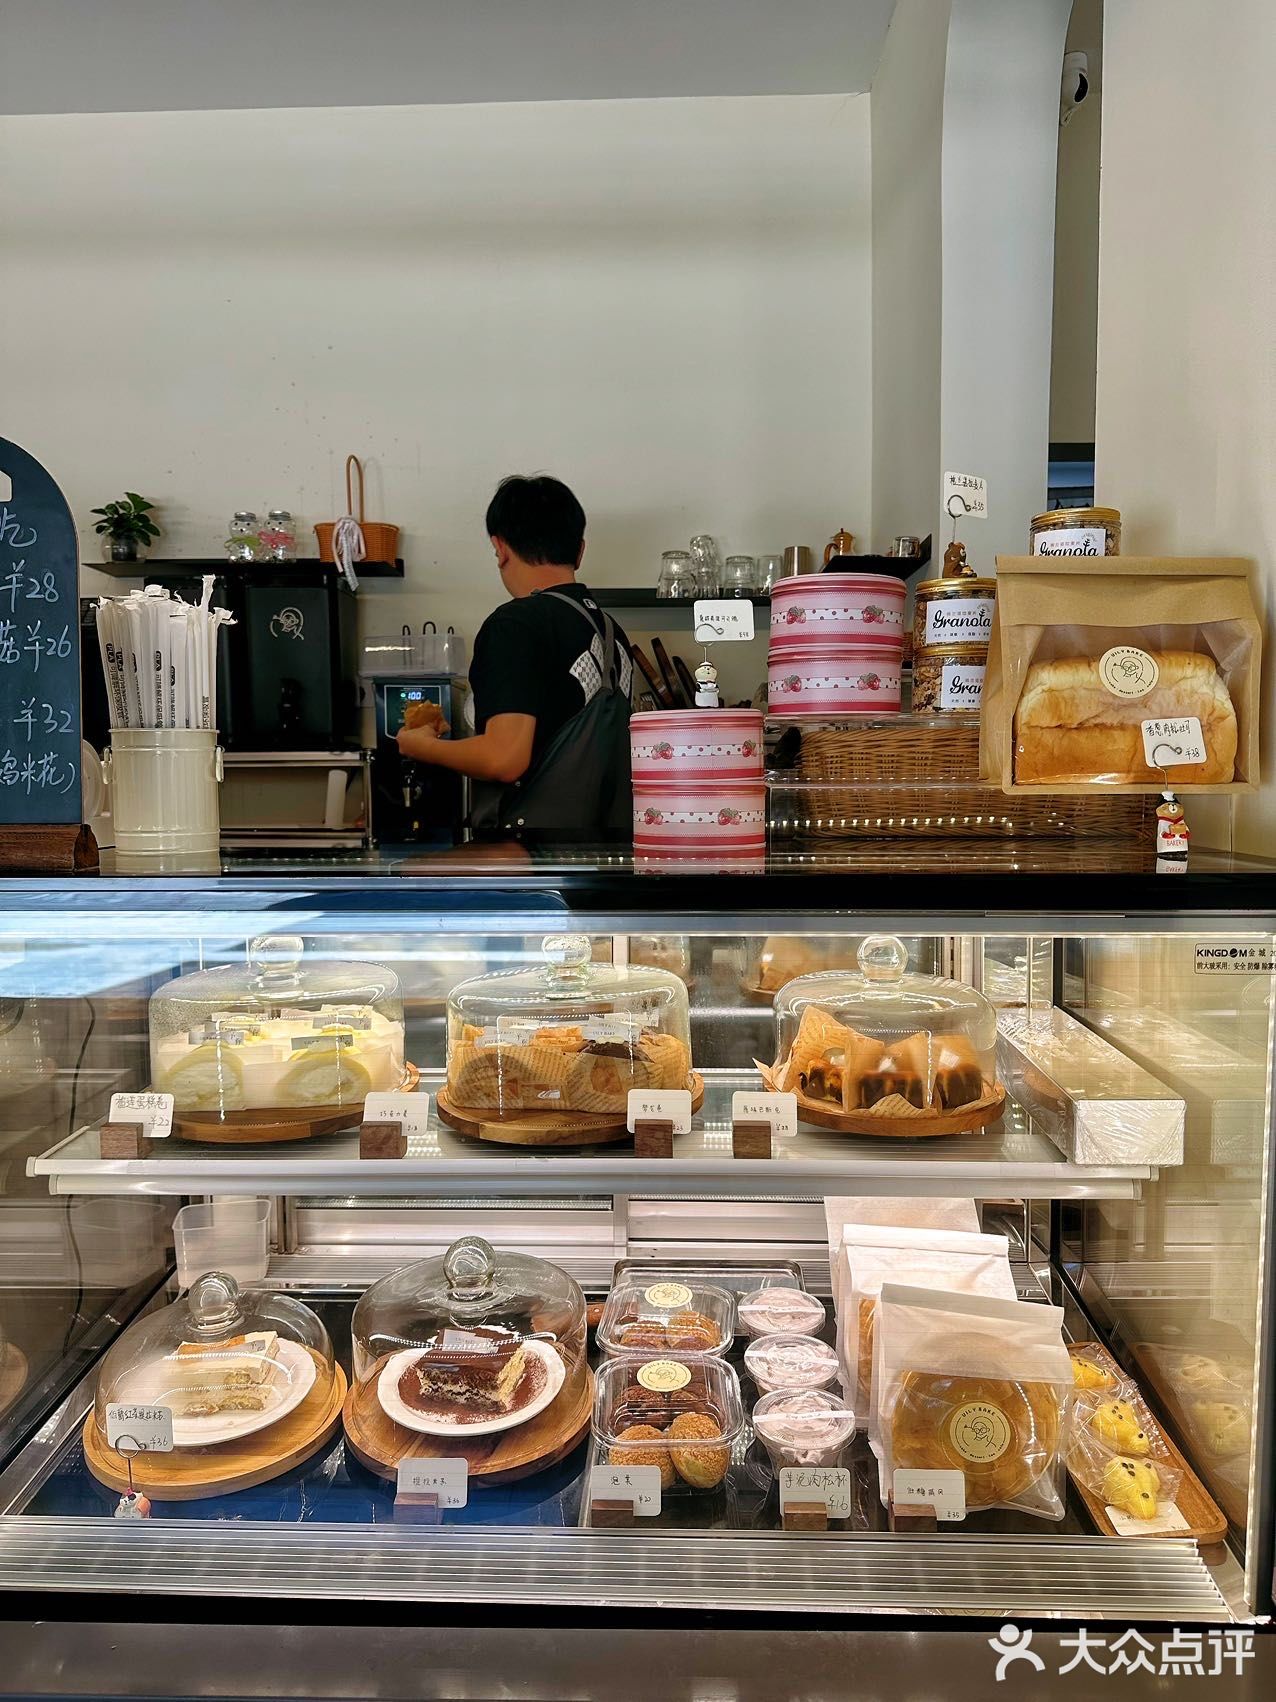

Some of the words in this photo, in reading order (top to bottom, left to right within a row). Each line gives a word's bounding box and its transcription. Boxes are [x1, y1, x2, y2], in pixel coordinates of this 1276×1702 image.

[932, 608, 992, 629] Granola
[407, 691, 422, 700] 100
[978, 1406, 996, 1417] BAKE
[150, 1434, 168, 1450] ¥36
[785, 1469, 848, 1491] 芋泥肉松杯
[827, 1494, 849, 1511] ¥16
